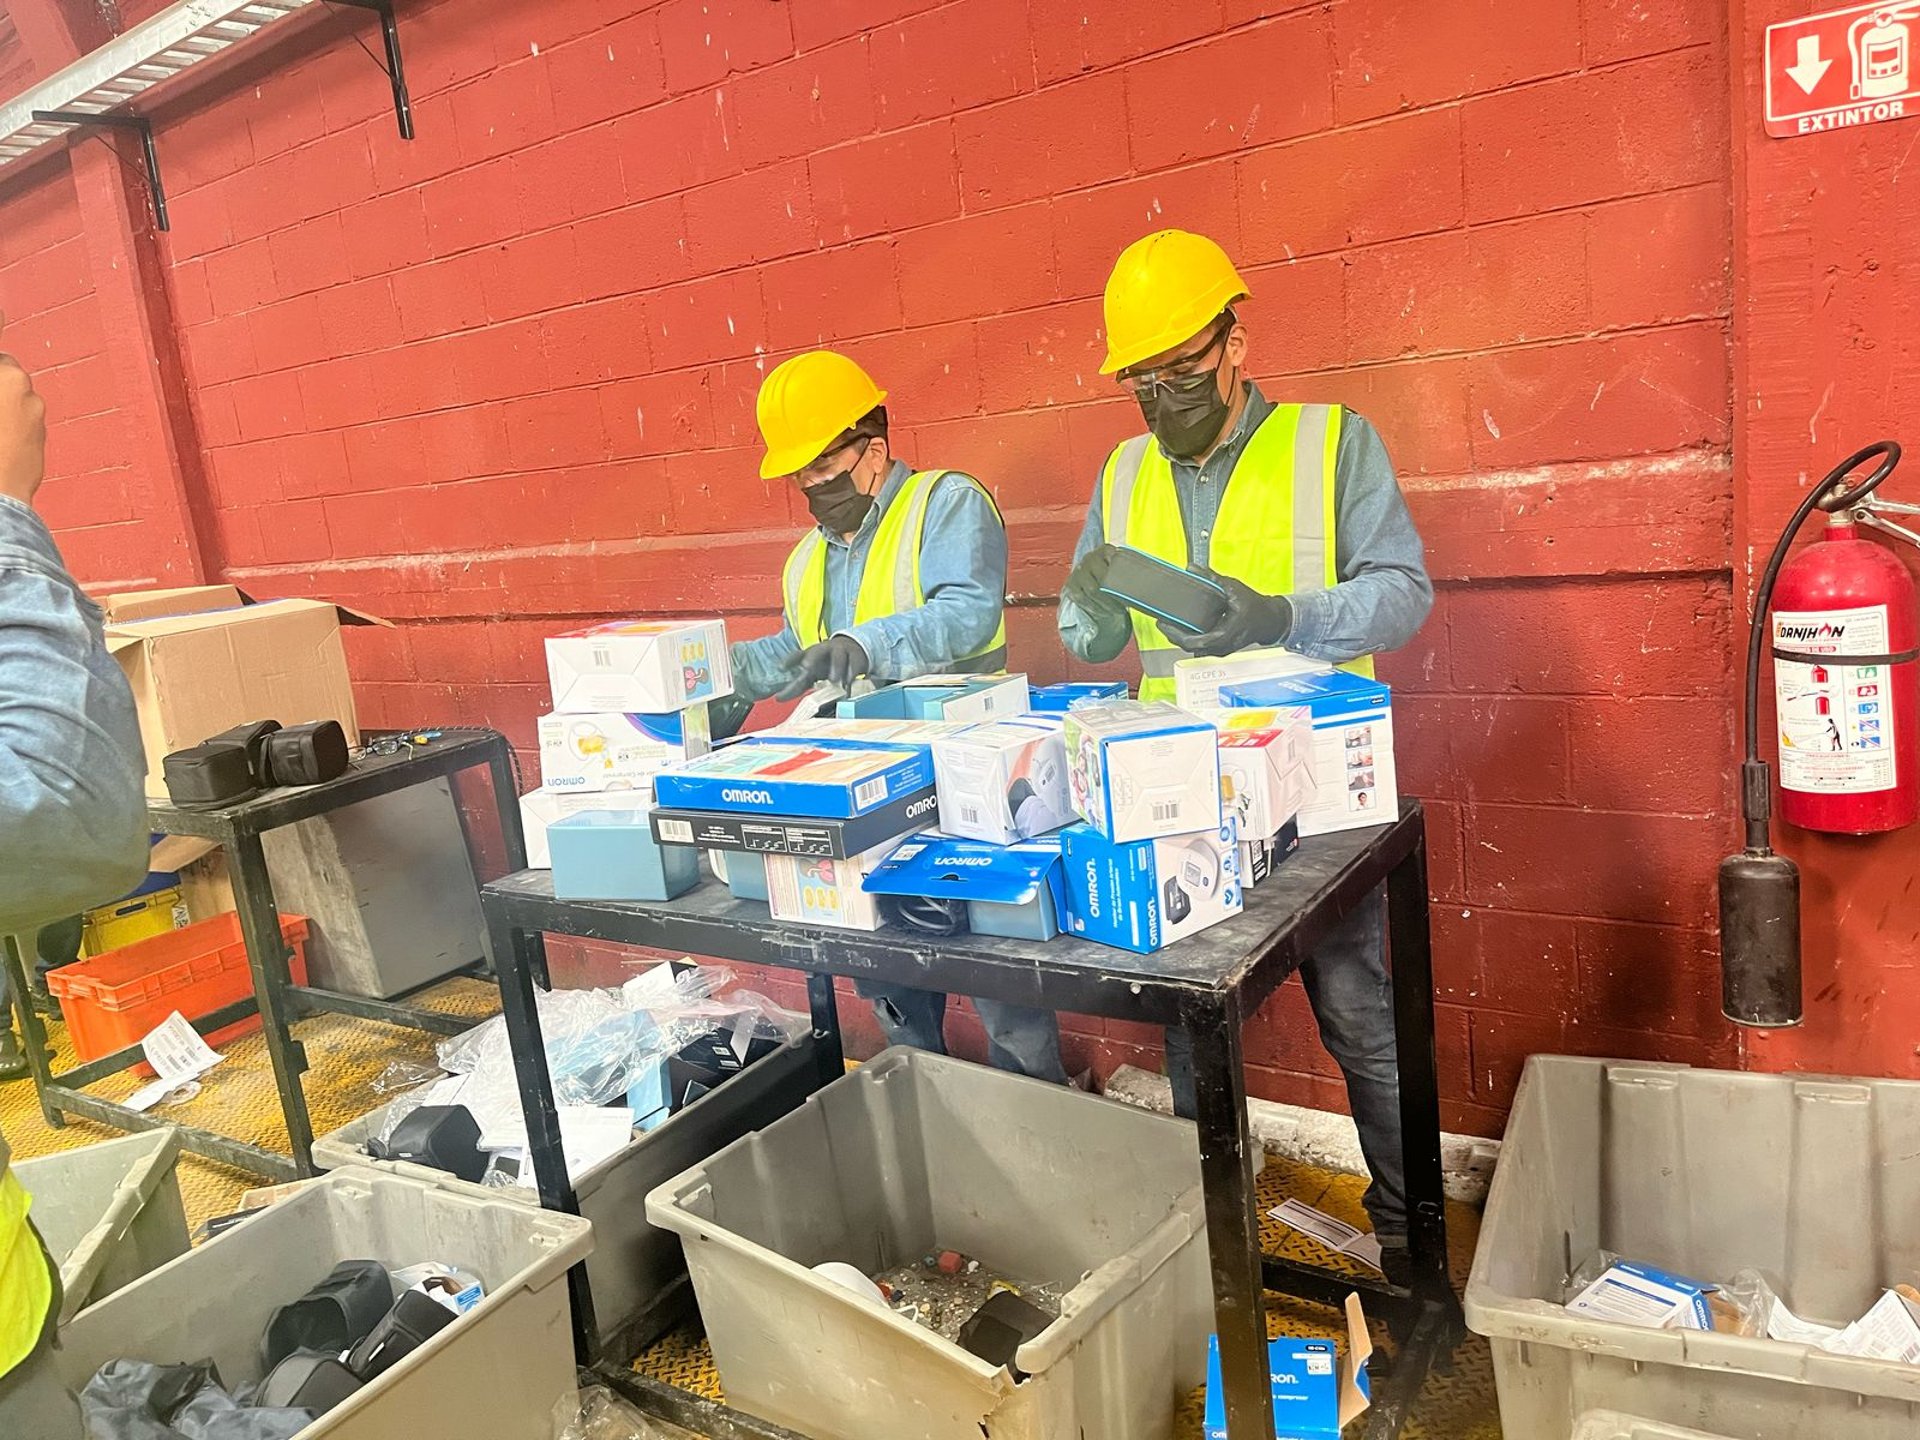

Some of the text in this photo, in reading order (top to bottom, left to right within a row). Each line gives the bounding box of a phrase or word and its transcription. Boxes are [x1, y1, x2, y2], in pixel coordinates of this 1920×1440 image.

[1798, 101, 1904, 134] EXTINTOR
[547, 776, 586, 787] OMRON
[722, 787, 771, 804] OMRON
[906, 794, 937, 819] OMRO
[935, 856, 993, 867] OMRON
[1087, 860, 1100, 917] OMRON
[1147, 899, 1158, 946] OMRON
[1270, 1373, 1296, 1384] RON
